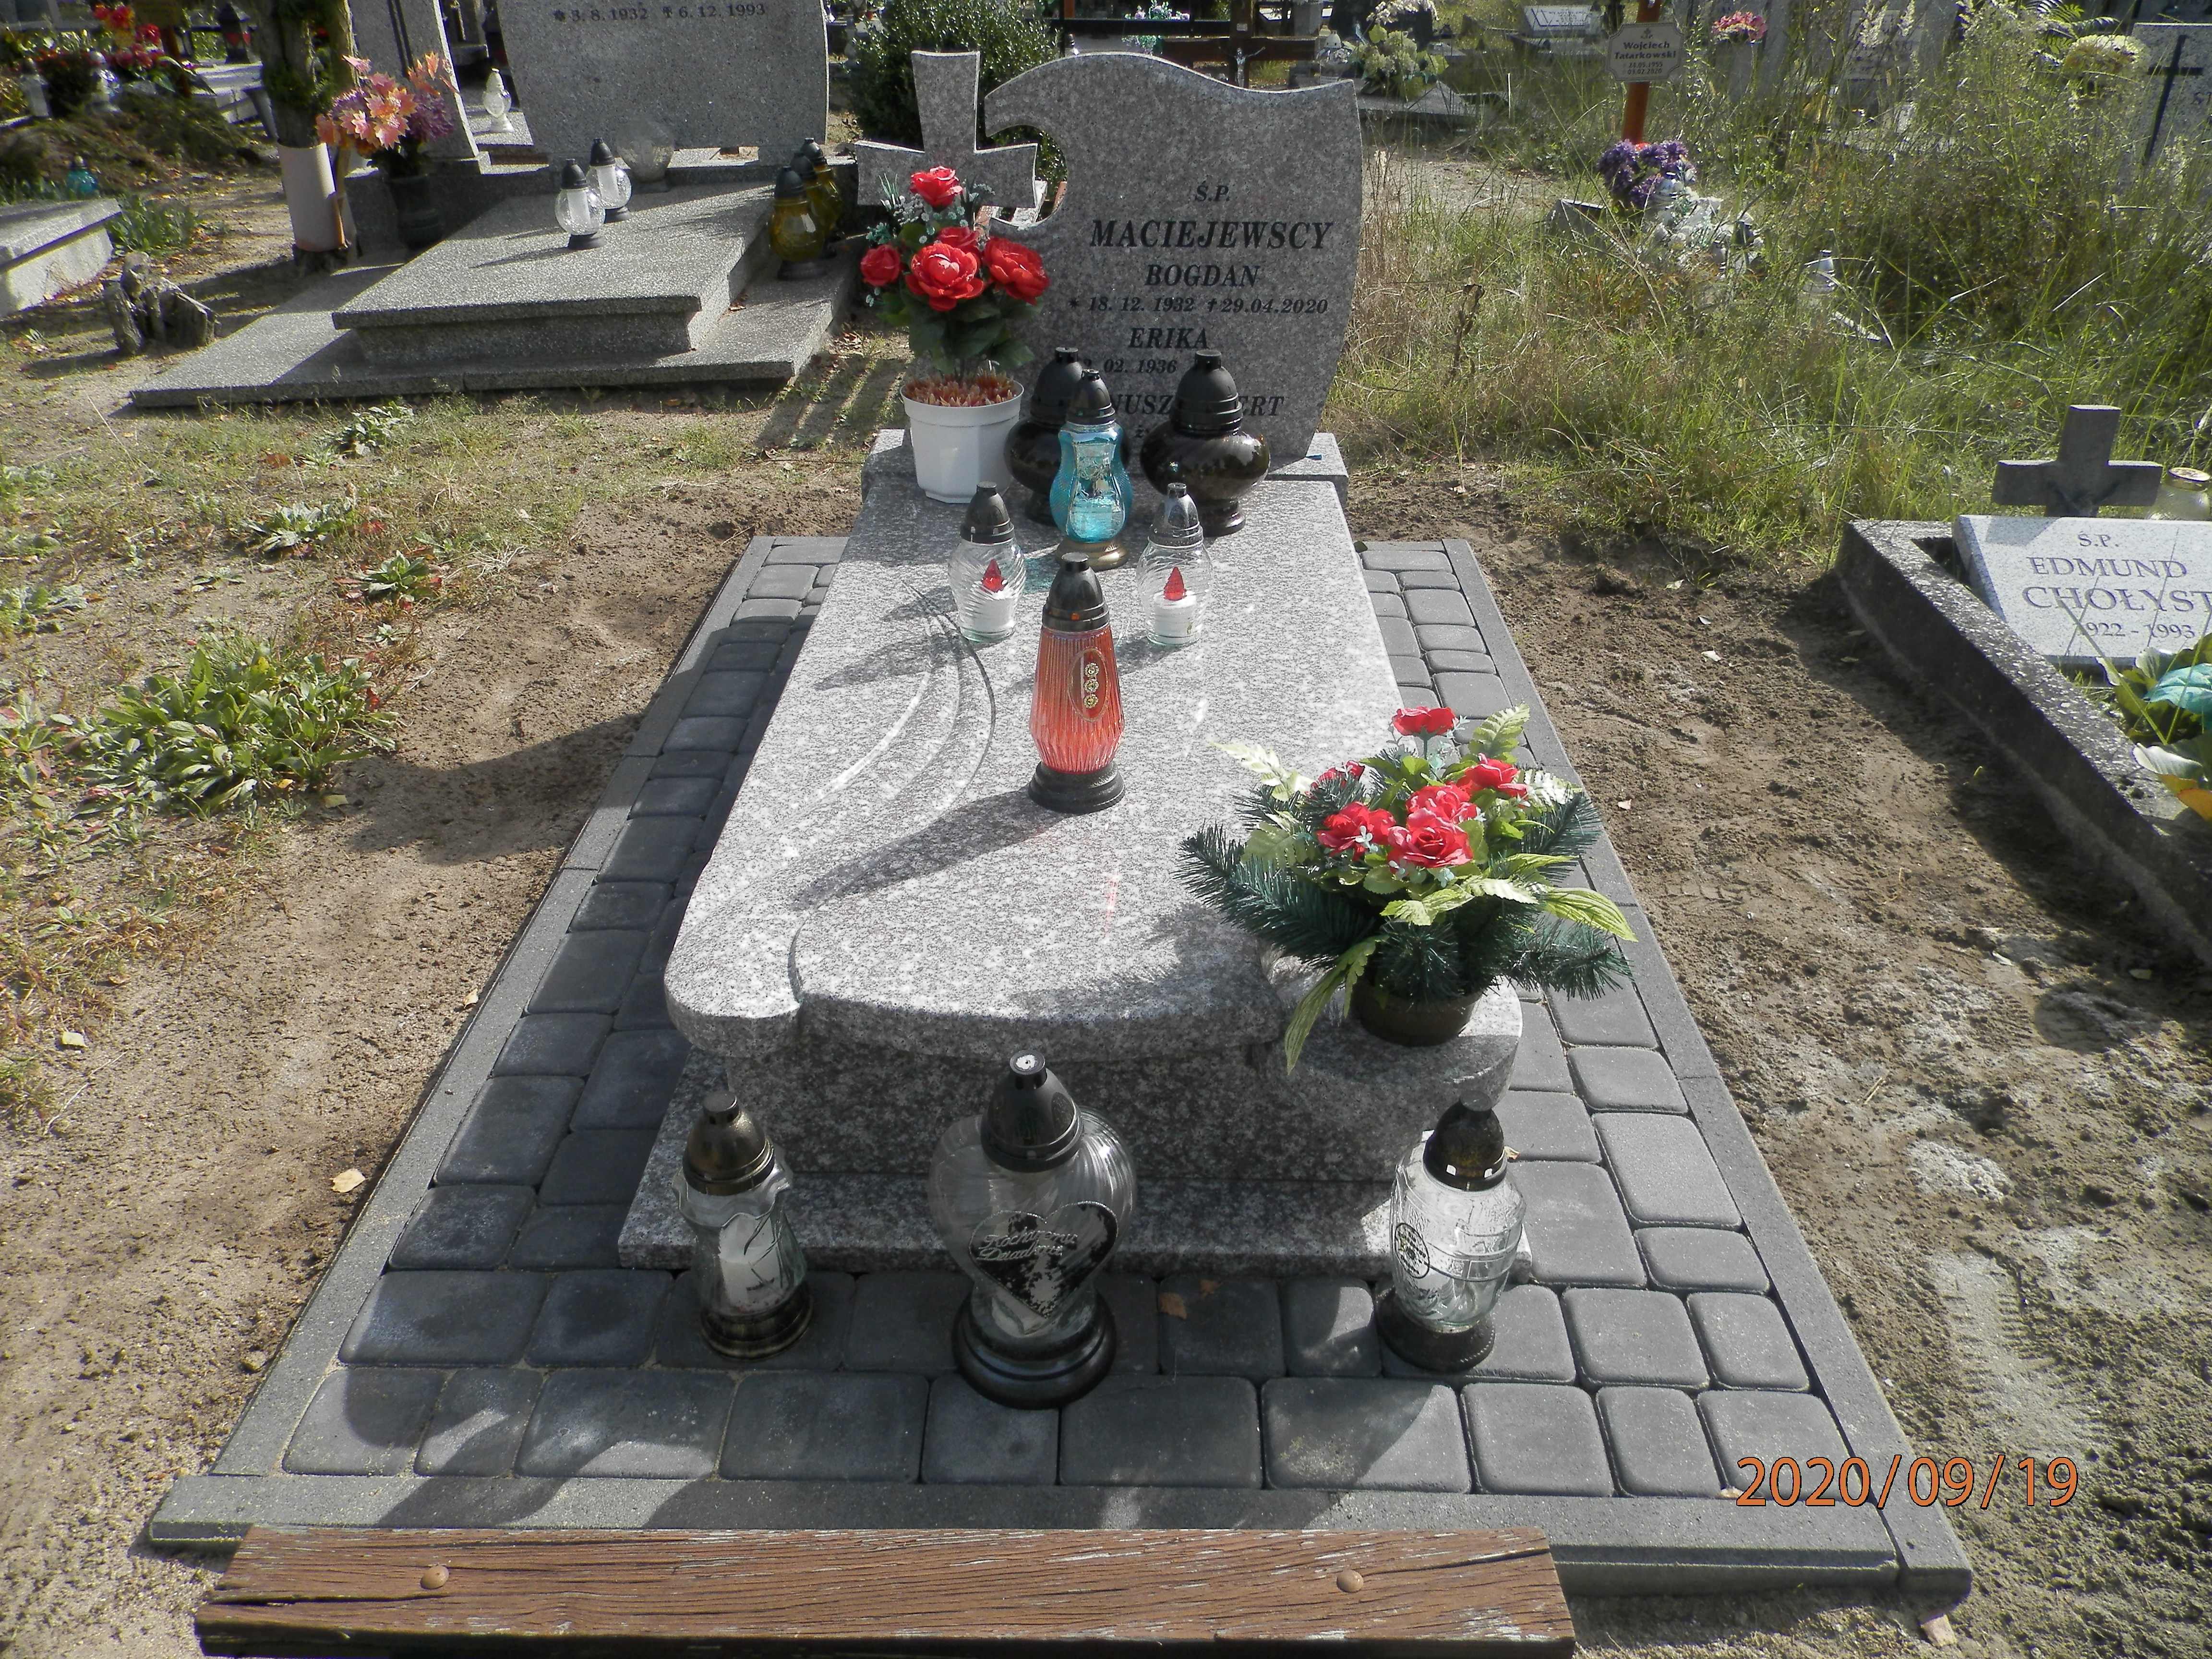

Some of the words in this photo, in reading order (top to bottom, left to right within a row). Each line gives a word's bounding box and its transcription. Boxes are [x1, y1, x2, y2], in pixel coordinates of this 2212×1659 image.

[1623, 41, 1670, 50] Wojciech
[1614, 51, 1676, 60] Tatarkowski
[1090, 219, 1333, 249] MACIEJEWSCY
[1144, 264, 1261, 287] BOGDAN
[1153, 297, 1194, 313] 1932
[1128, 327, 1209, 349] ERIKA
[1136, 359, 1178, 374] 1936
[2026, 556, 2188, 578] EDMUND
[2144, 624, 2195, 639] 1993
